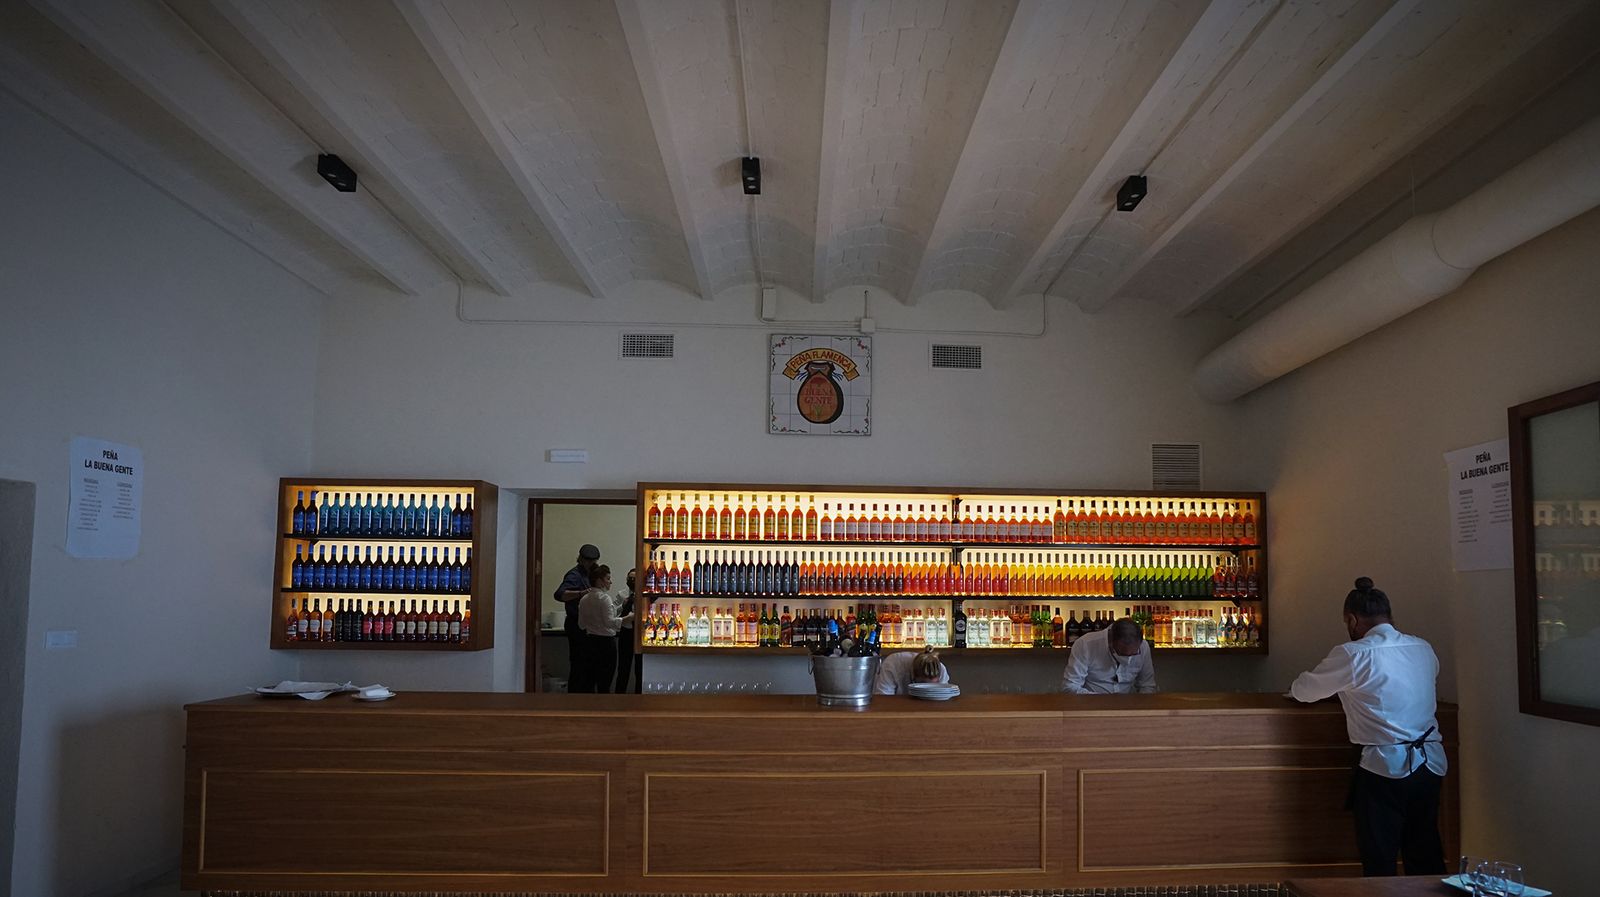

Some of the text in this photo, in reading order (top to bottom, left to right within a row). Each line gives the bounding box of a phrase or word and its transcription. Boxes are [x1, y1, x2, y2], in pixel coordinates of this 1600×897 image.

[812, 350, 853, 370] FLAMENCA
[102, 449, 119, 461] PEÑA
[1475, 451, 1492, 464] PEÑA
[84, 459, 134, 476] LA BUENA GENTE
[1460, 462, 1509, 480] LA BUENA GENTE
